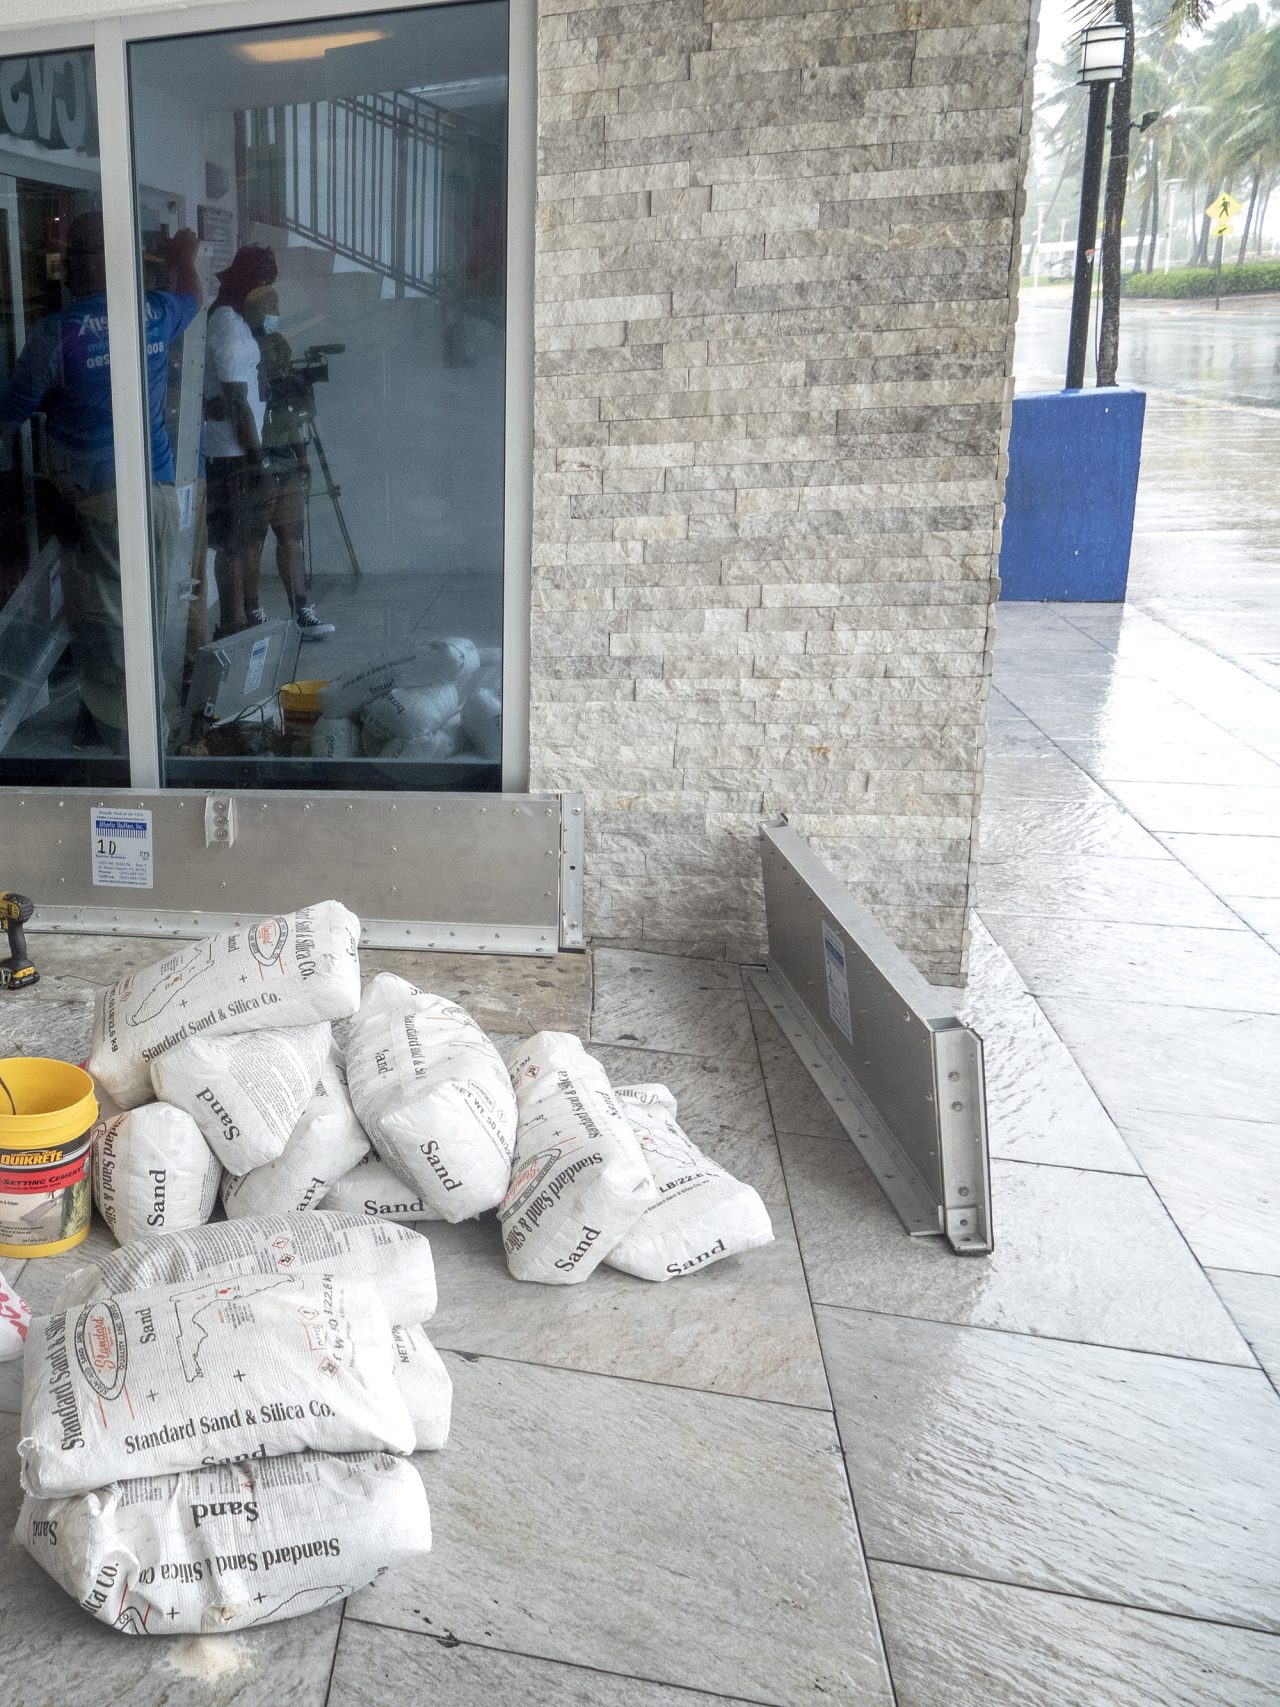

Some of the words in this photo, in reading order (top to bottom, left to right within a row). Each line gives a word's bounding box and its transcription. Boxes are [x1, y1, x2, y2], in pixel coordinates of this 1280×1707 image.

[141, 1023, 188, 1063] Standard
[187, 1013, 216, 1035] Sand
[217, 1008, 227, 1021] &
[227, 997, 260, 1017] Silica
[261, 991, 282, 1008] Co.
[452, 1082, 473, 1099] NET
[196, 1086, 241, 1141] Sand
[0, 1151, 63, 1166] QUIKRETE
[48, 1167, 81, 1183] CEMENT
[102, 1159, 115, 1193] Sand
[419, 1139, 464, 1192] Sand
[548, 1153, 603, 1200] Standard
[147, 1169, 167, 1226] Sand
[364, 1200, 425, 1216] Sand
[524, 1190, 554, 1227] Sand
[554, 1225, 602, 1272] Sand
[666, 1239, 727, 1276] Sand
[135, 1307, 157, 1344] Sand
[45, 1345, 71, 1385] Sand
[49, 1380, 85, 1450] Standard
[125, 1418, 197, 1455] Standard
[199, 1409, 242, 1437] Sand
[245, 1408, 258, 1425] &
[260, 1403, 305, 1424] Silica
[308, 1399, 336, 1419] Co.
[190, 1500, 259, 1528] Sand
[161, 1561, 203, 1584] Silica
[263, 1538, 341, 1573] Standard
